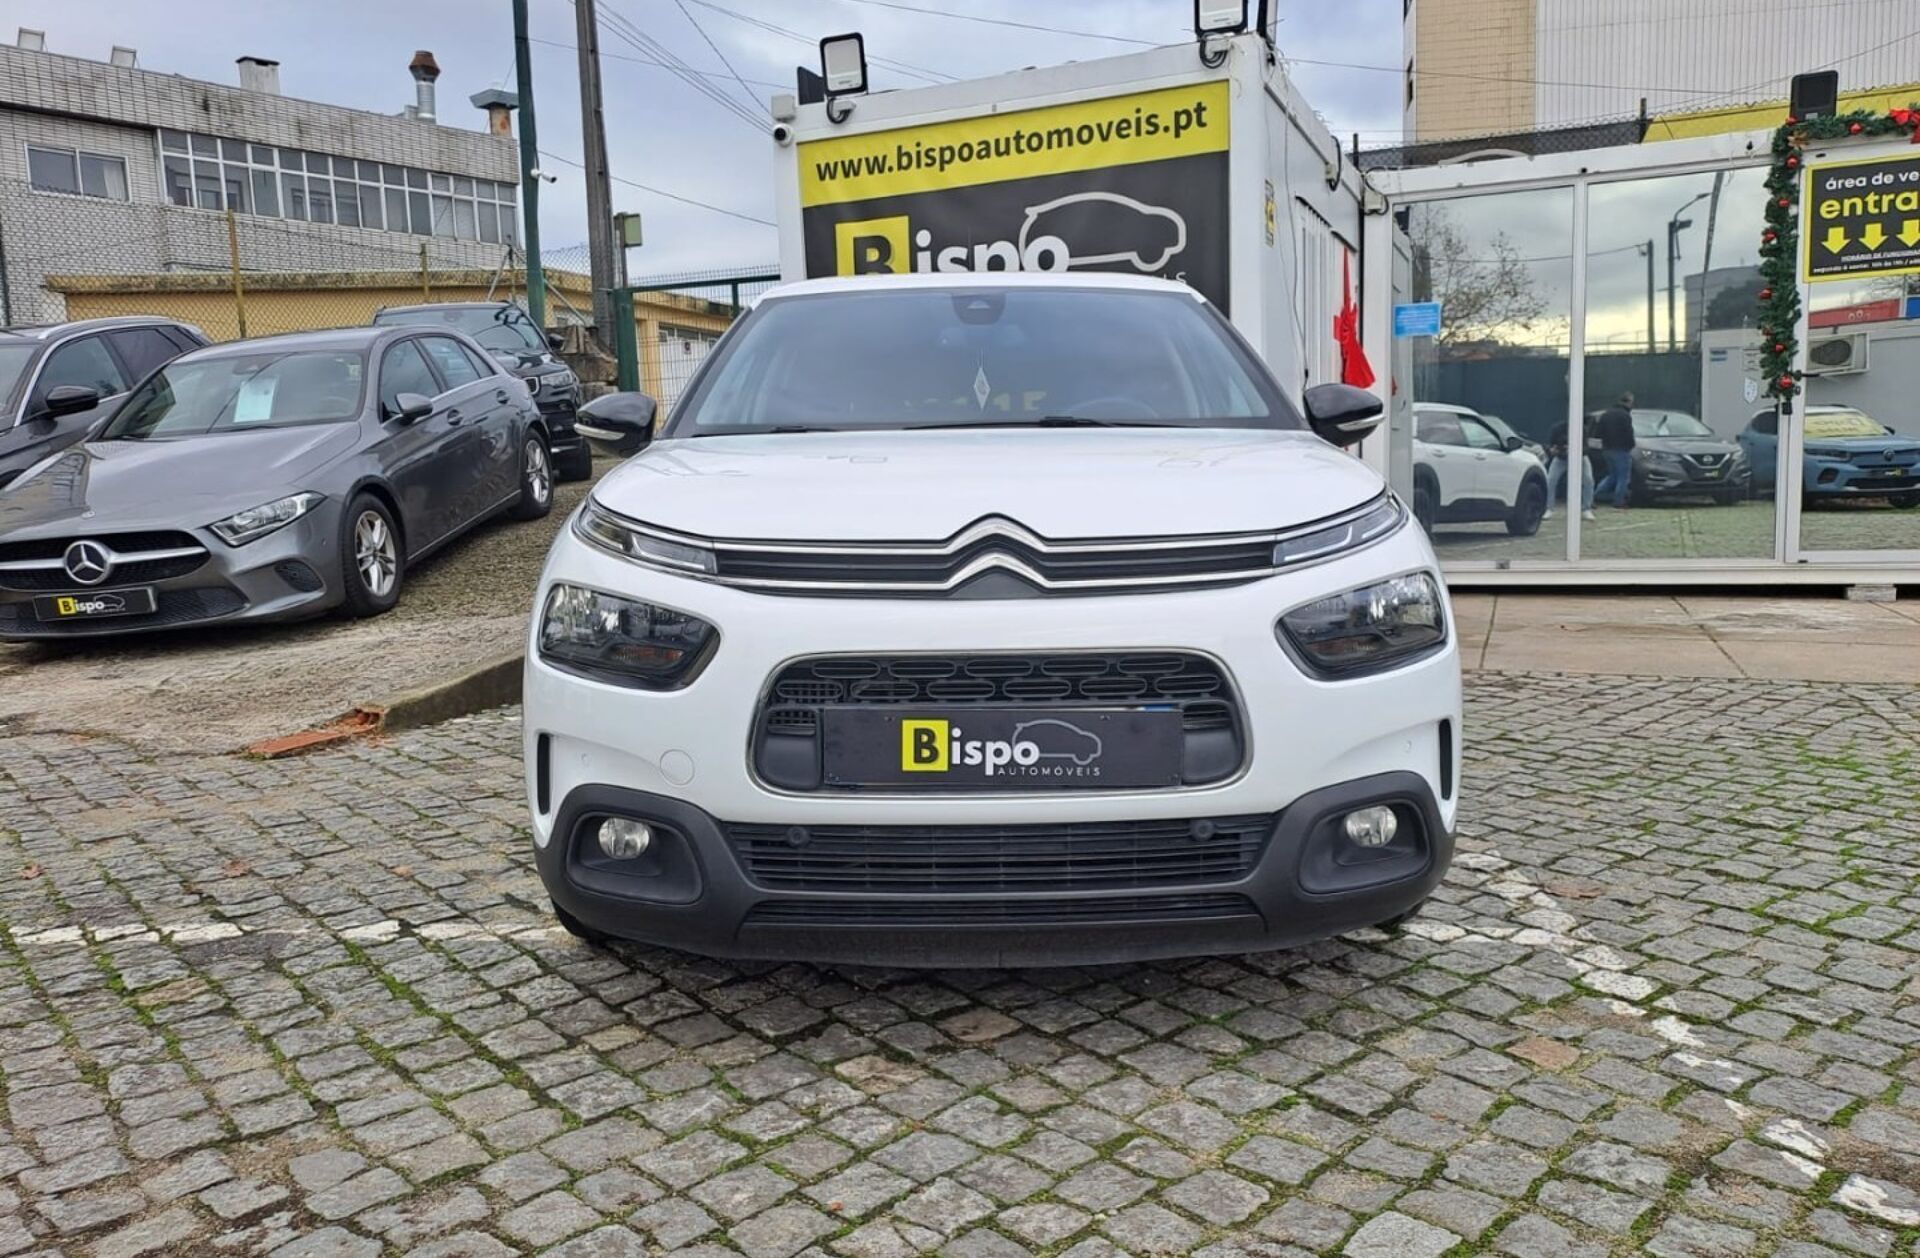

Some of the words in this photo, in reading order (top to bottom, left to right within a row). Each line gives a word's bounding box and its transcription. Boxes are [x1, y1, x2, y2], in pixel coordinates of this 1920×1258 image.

[816, 101, 1208, 182] www.bispoautomoveis.pt
[1825, 176, 1867, 190] área
[1871, 172, 1894, 186] de
[1819, 191, 1919, 219] entra
[62, 599, 105, 614] Bispo
[912, 727, 1040, 776] Bispo
[997, 766, 1101, 777] AUTOMÓVEIS
